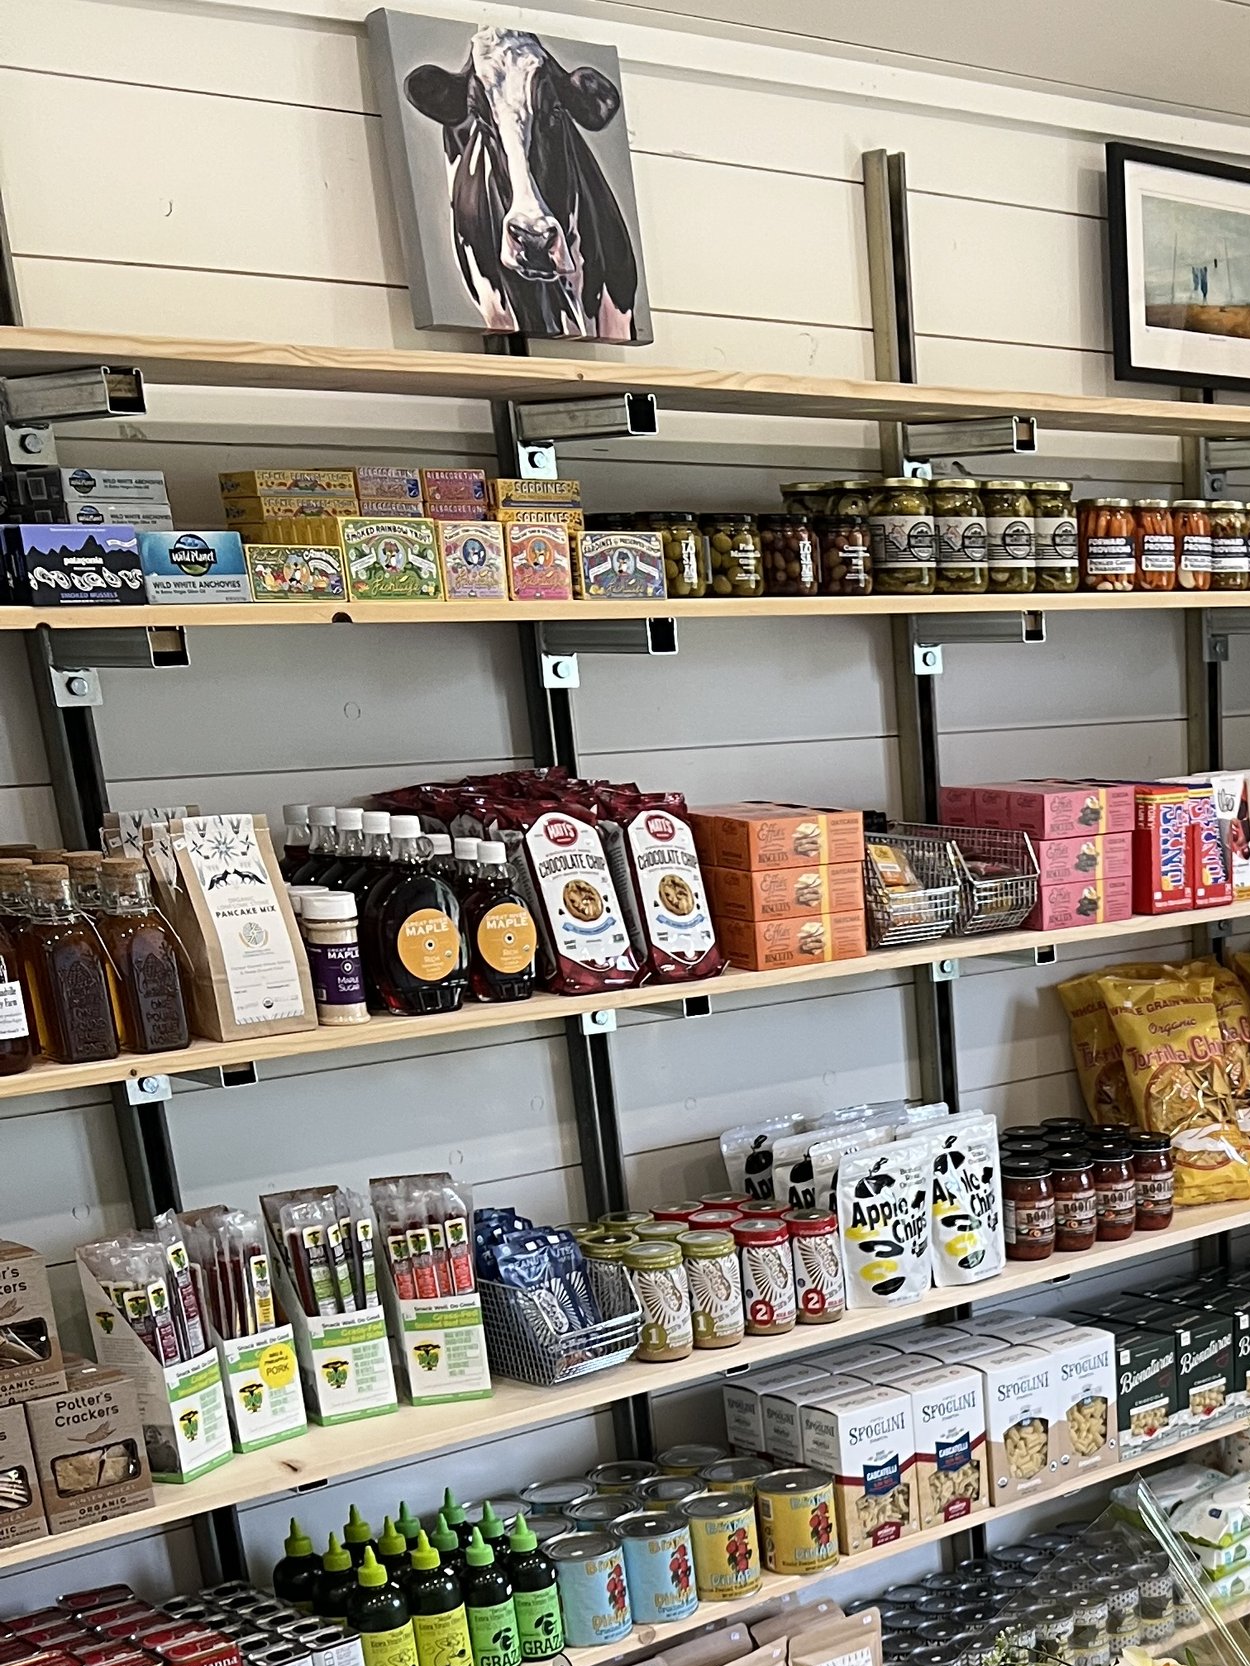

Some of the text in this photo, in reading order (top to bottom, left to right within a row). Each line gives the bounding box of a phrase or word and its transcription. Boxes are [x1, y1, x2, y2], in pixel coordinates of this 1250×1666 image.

[514, 482, 568, 494] SARDINES
[173, 581, 197, 590] WHITE
[199, 580, 242, 589] ANCHOVIES
[216, 905, 276, 918] PANCAKE MIX
[405, 922, 449, 937] MAPLE
[486, 917, 529, 929] MAPLE
[327, 950, 359, 960] MAPLE
[1147, 1016, 1197, 1035] Organic
[1127, 1044, 1190, 1076] Tortilla
[807, 1293, 819, 1309] 2
[756, 1303, 768, 1320] 2
[266, 1363, 289, 1377] PORK
[55, 1392, 113, 1413] Potter's
[54, 1404, 119, 1427] Crackers
[79, 1496, 127, 1516] ORGANIC
